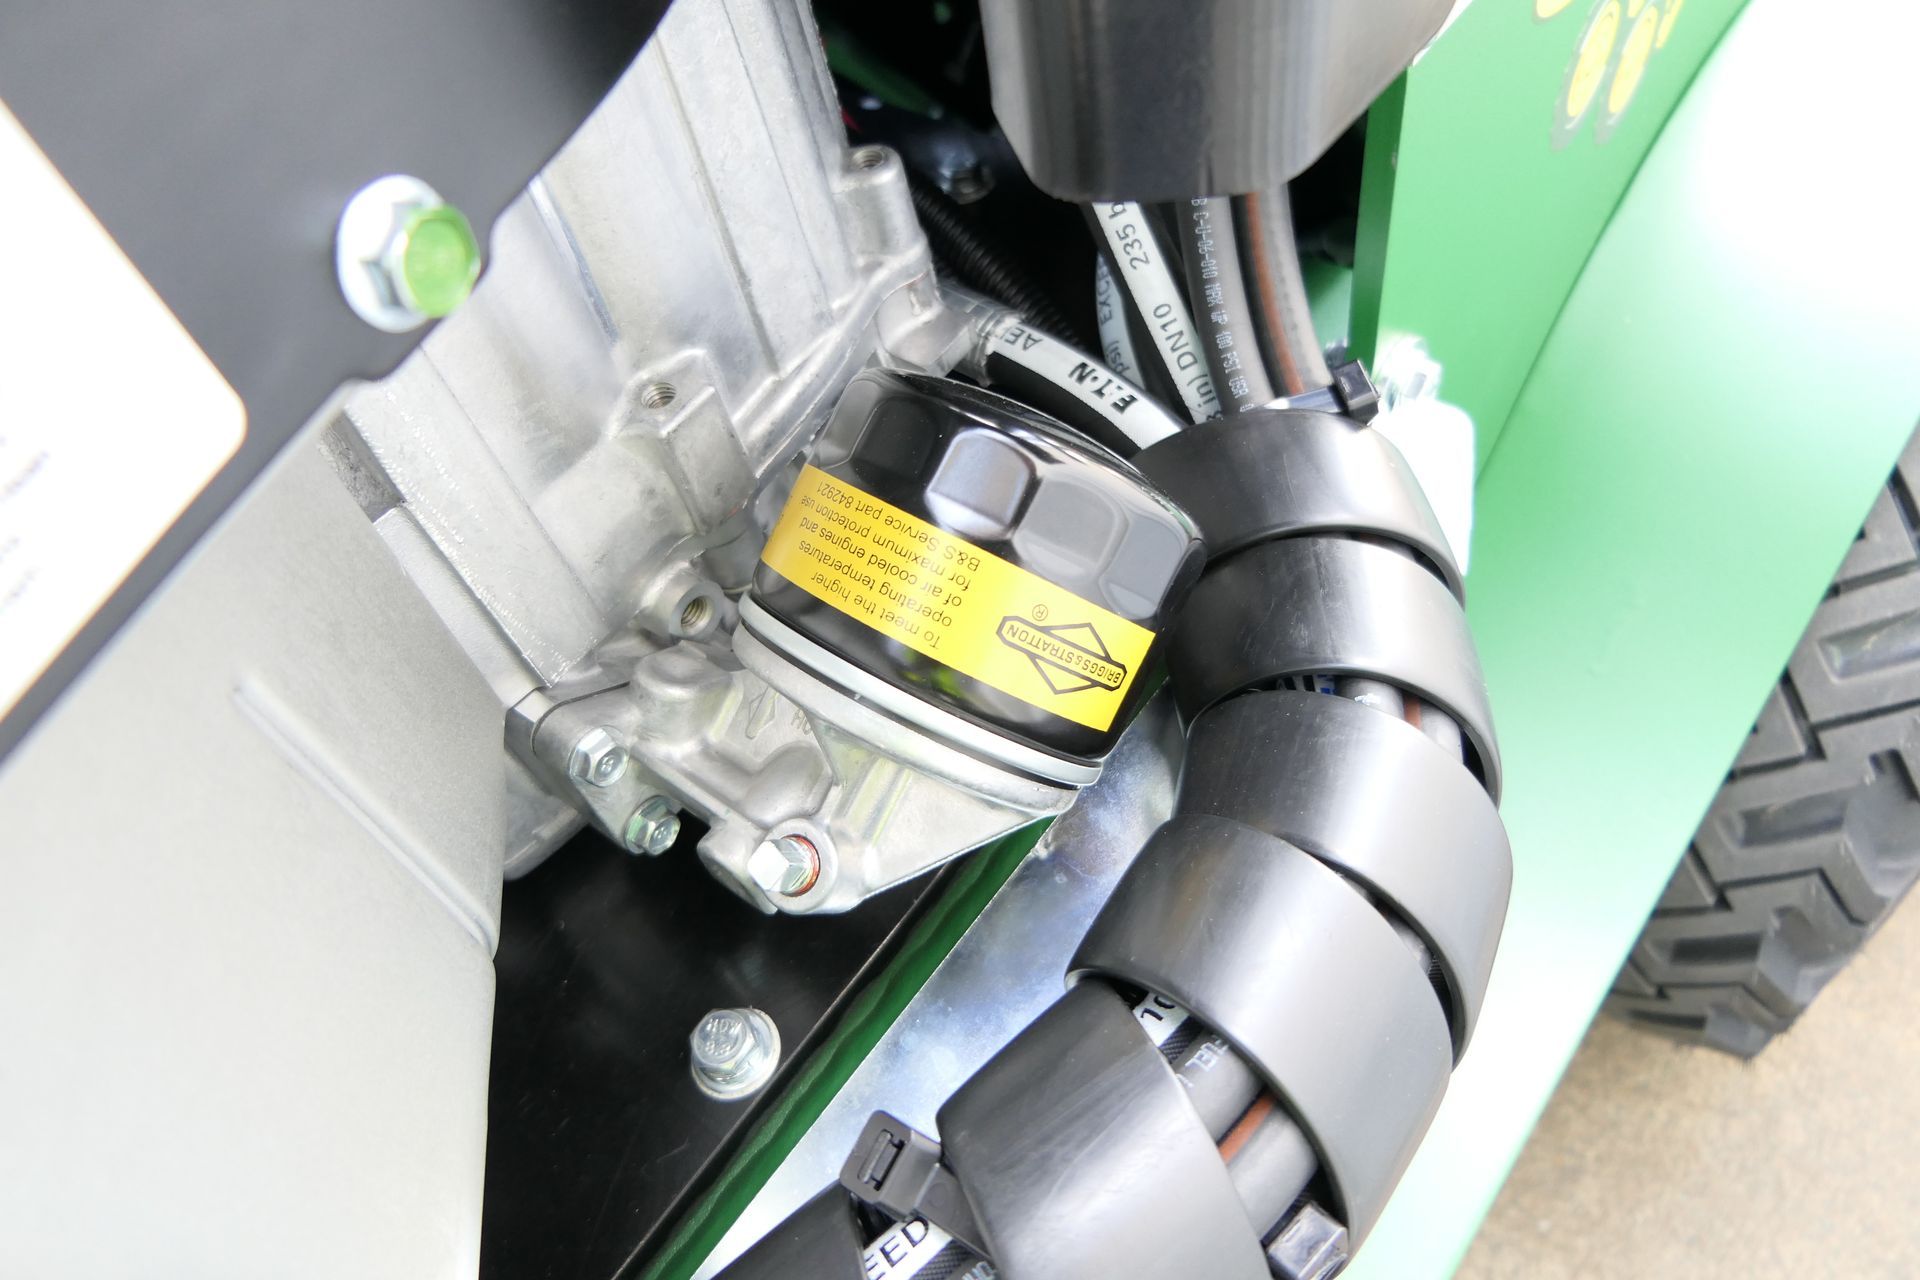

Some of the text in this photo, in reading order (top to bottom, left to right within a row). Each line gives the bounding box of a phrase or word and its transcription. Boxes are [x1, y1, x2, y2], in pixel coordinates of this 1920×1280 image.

[1115, 223, 1150, 270] 235
[1153, 303, 1199, 371] DN10
[799, 516, 962, 607] of air cooled engines and
[801, 495, 972, 592] for maximum protection use
[817, 481, 981, 573] B&S Service part 842921
[799, 540, 953, 628] operating temperatures
[811, 571, 941, 650] To meet the higher
